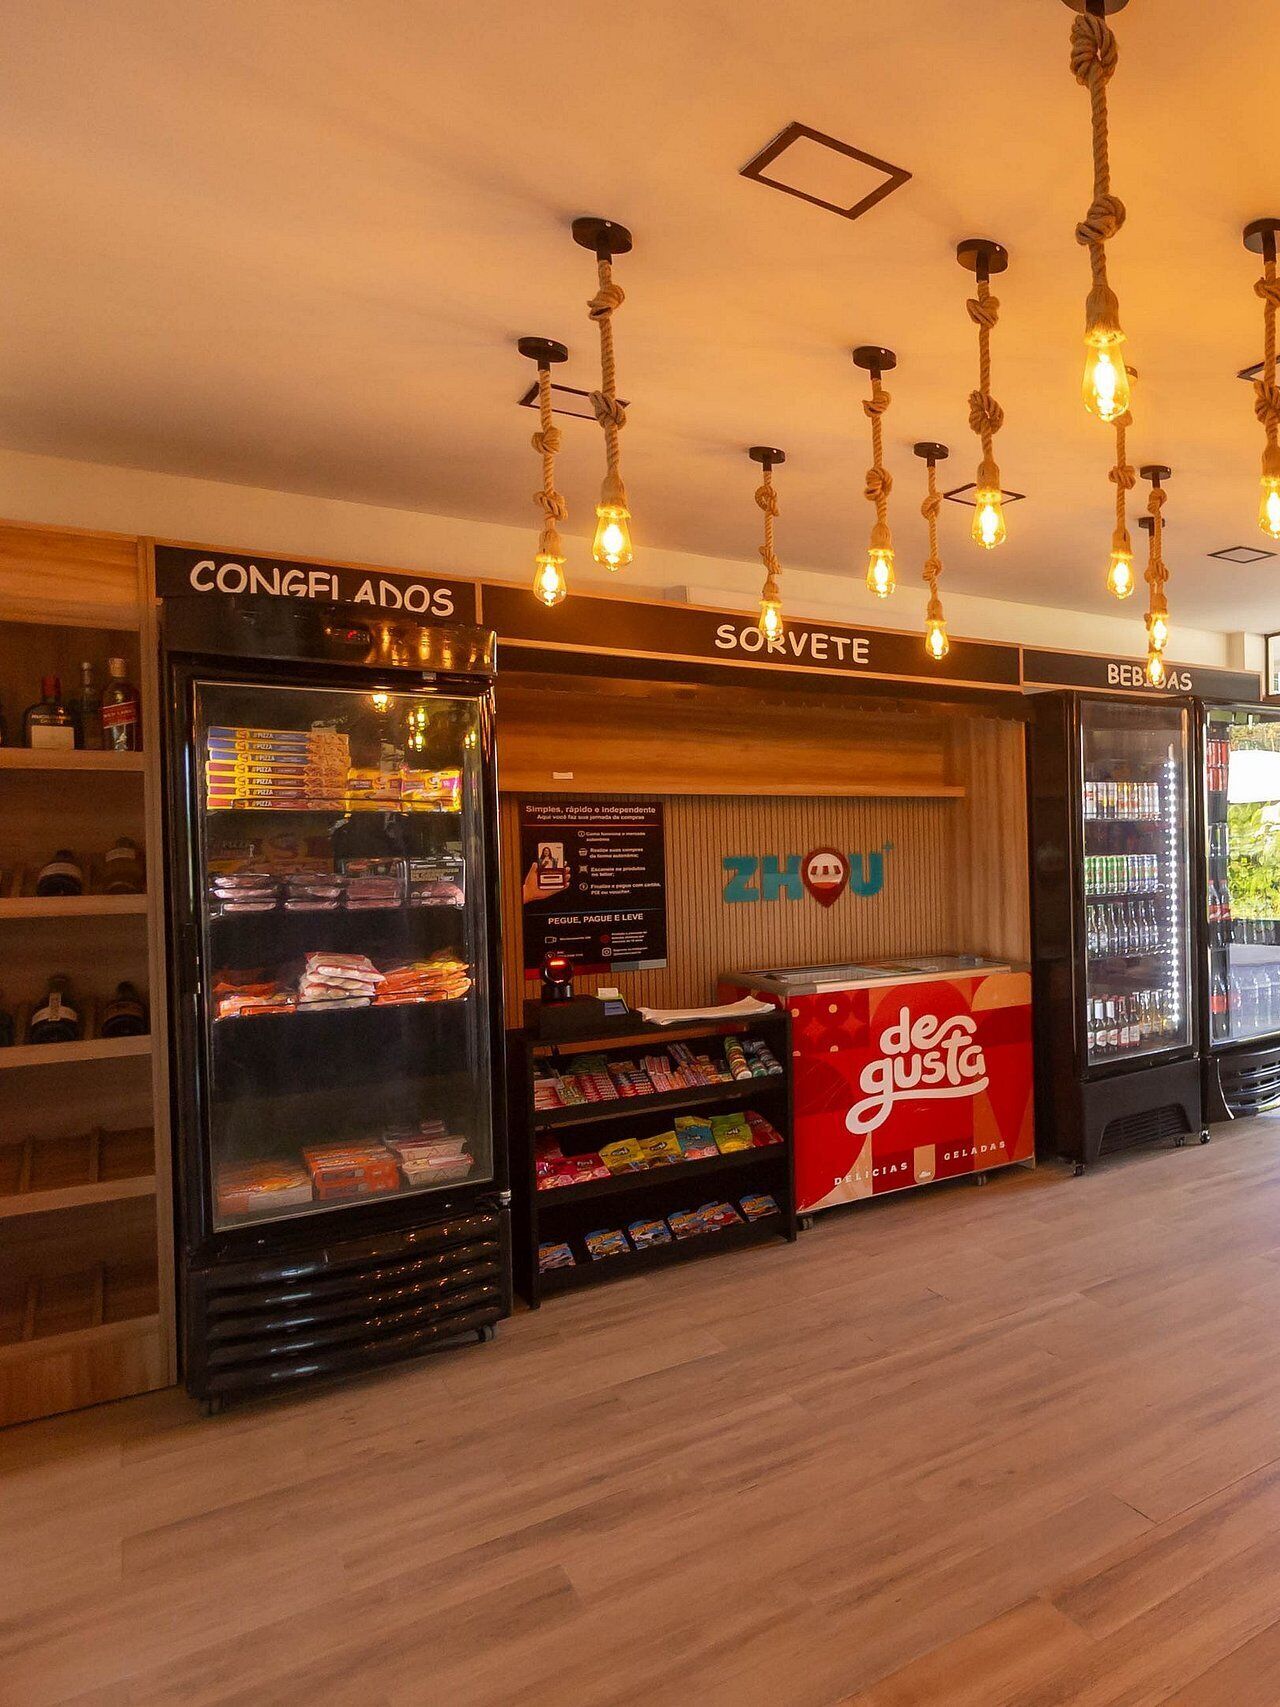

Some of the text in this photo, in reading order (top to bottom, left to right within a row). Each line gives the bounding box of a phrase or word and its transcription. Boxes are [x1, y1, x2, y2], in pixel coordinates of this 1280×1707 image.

[715, 624, 870, 664] SORVETE
[565, 805, 593, 814] rápido
[601, 806, 656, 814] independente
[548, 912, 644, 925] PEGUE, PAGUE E LEVE
[943, 1141, 1006, 1161] GELADAS
